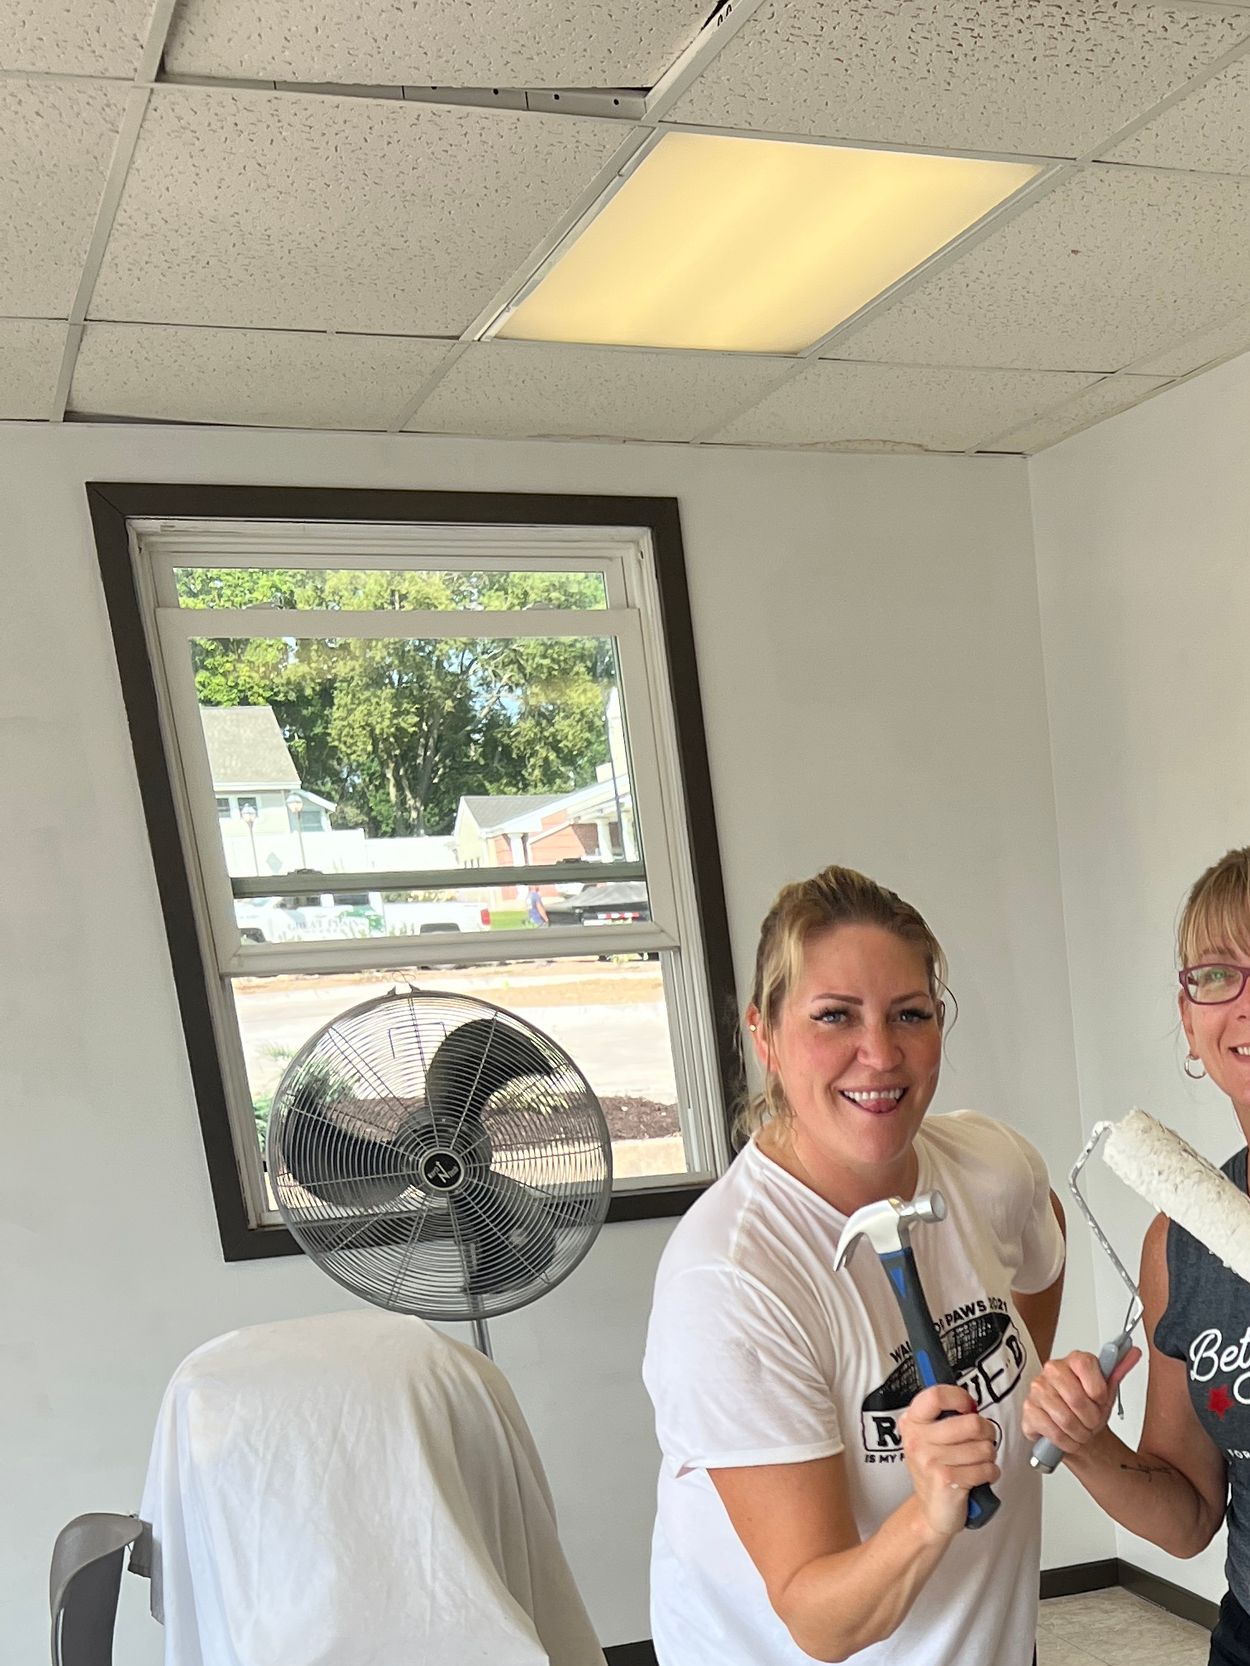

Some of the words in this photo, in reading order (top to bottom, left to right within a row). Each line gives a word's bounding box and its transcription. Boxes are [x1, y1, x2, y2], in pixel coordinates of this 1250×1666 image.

[945, 1300, 987, 1326] PAWS
[864, 1454, 876, 1463] IS
[879, 1454, 897, 1464] MY
